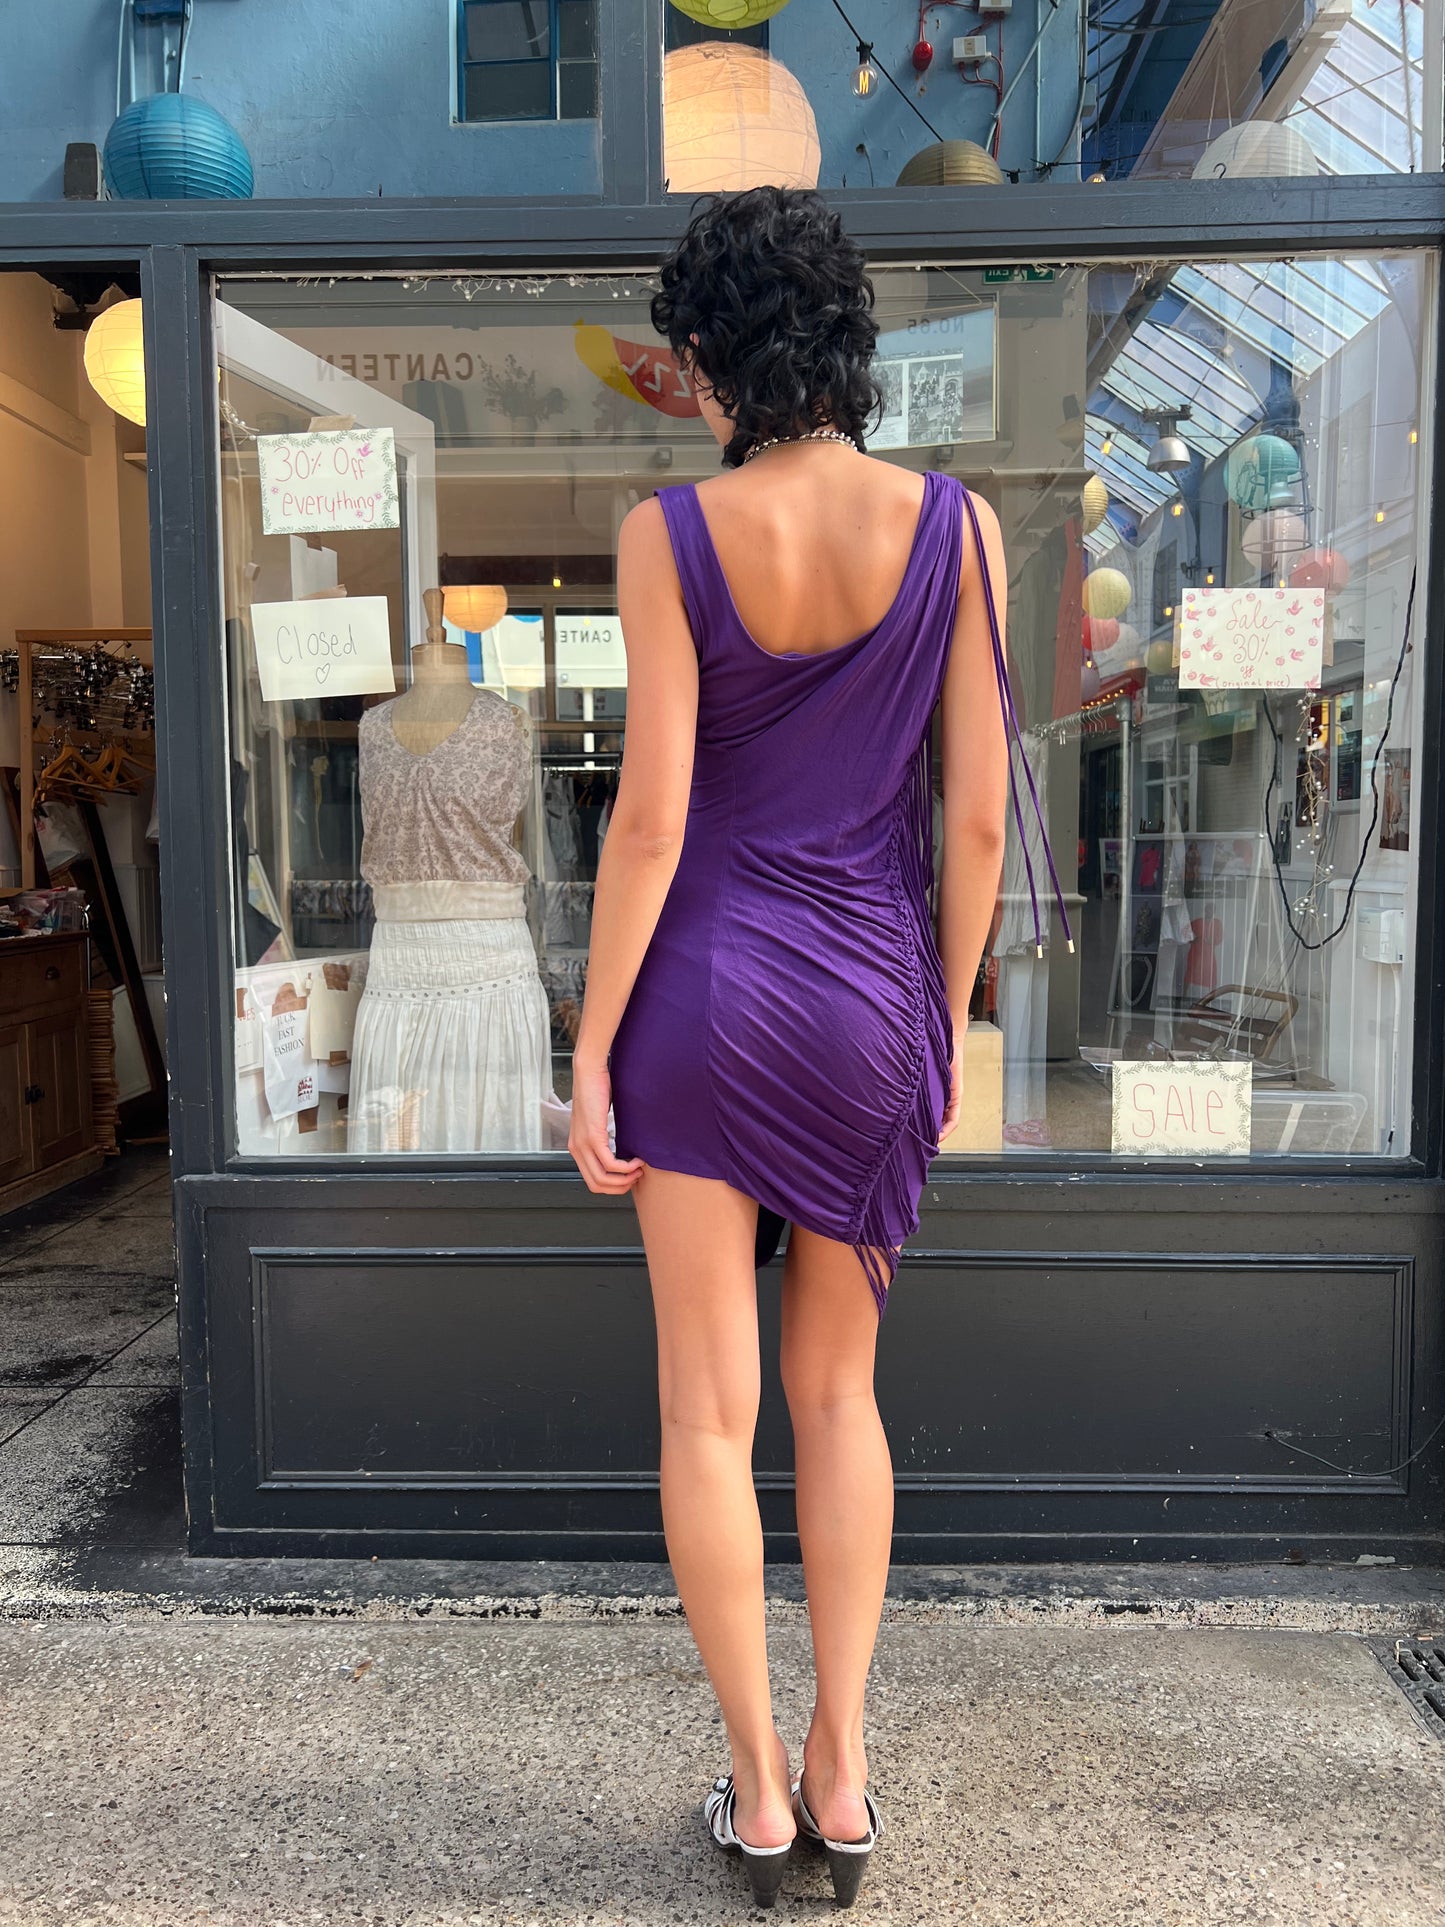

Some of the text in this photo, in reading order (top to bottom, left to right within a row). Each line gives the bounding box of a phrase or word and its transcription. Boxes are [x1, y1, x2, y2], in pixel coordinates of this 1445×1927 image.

[273, 446, 366, 482] 30% Off
[282, 489, 375, 523] everything
[1226, 599, 1281, 631] Sale
[277, 623, 358, 665] Closed
[1233, 633, 1270, 664] 30%
[1240, 665, 1255, 680] off
[274, 1037, 304, 1057] FASHION
[278, 1026, 295, 1041] FAST
